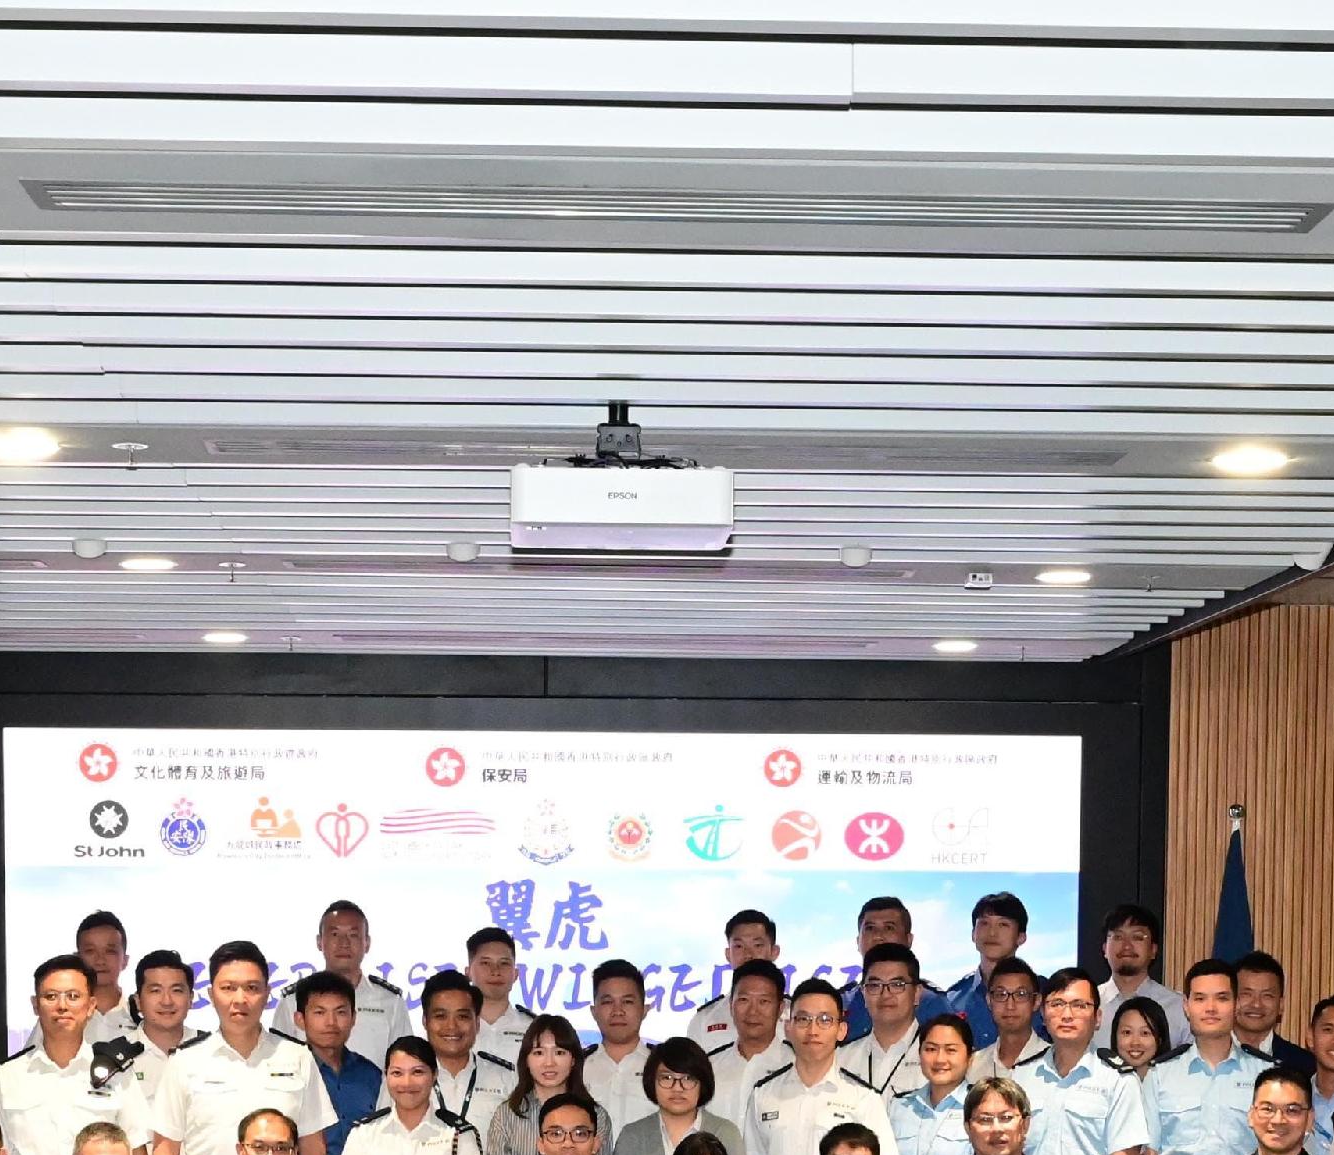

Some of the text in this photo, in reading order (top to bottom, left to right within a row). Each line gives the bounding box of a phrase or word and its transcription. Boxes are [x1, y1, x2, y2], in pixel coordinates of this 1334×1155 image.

[608, 492, 637, 500] EPSON
[134, 765, 266, 781] 文化體育及旅遊局
[482, 768, 528, 783] 保安局
[817, 769, 914, 786] 運輸及物流局
[74, 845, 145, 858] St John
[931, 853, 988, 865] HKCERT
[486, 879, 608, 951] 翼虎
